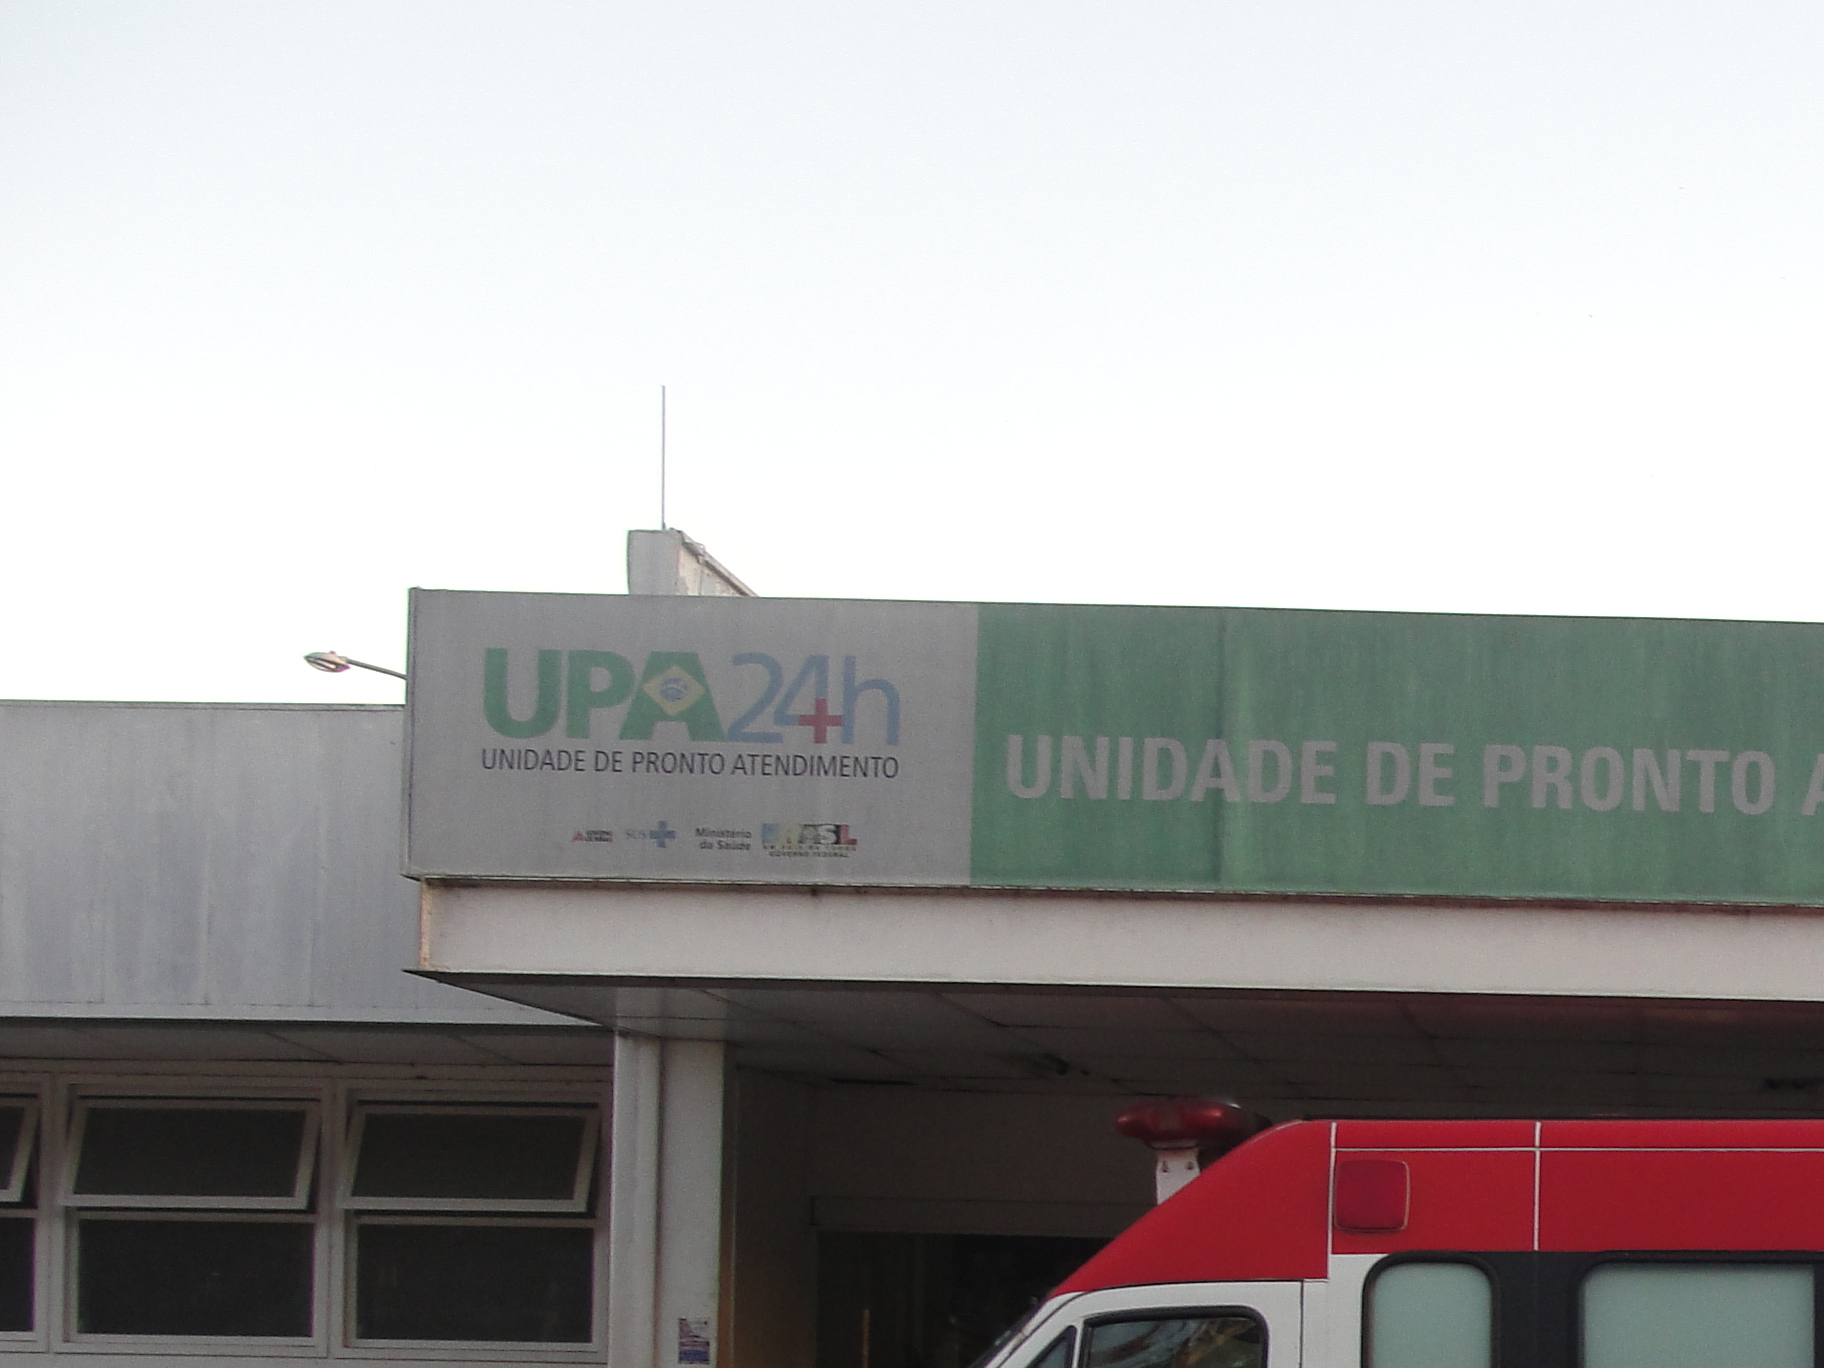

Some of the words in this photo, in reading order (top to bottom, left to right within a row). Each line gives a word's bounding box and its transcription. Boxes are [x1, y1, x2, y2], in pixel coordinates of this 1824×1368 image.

[481, 748, 586, 773] UNIDADE
[593, 750, 624, 774] DE
[631, 751, 726, 776] PRONTO
[731, 754, 900, 779] ATENDIMENTO
[1006, 733, 1338, 804] UNIDADE
[1364, 741, 1456, 807] DE
[1482, 744, 1776, 816] PRONTO
